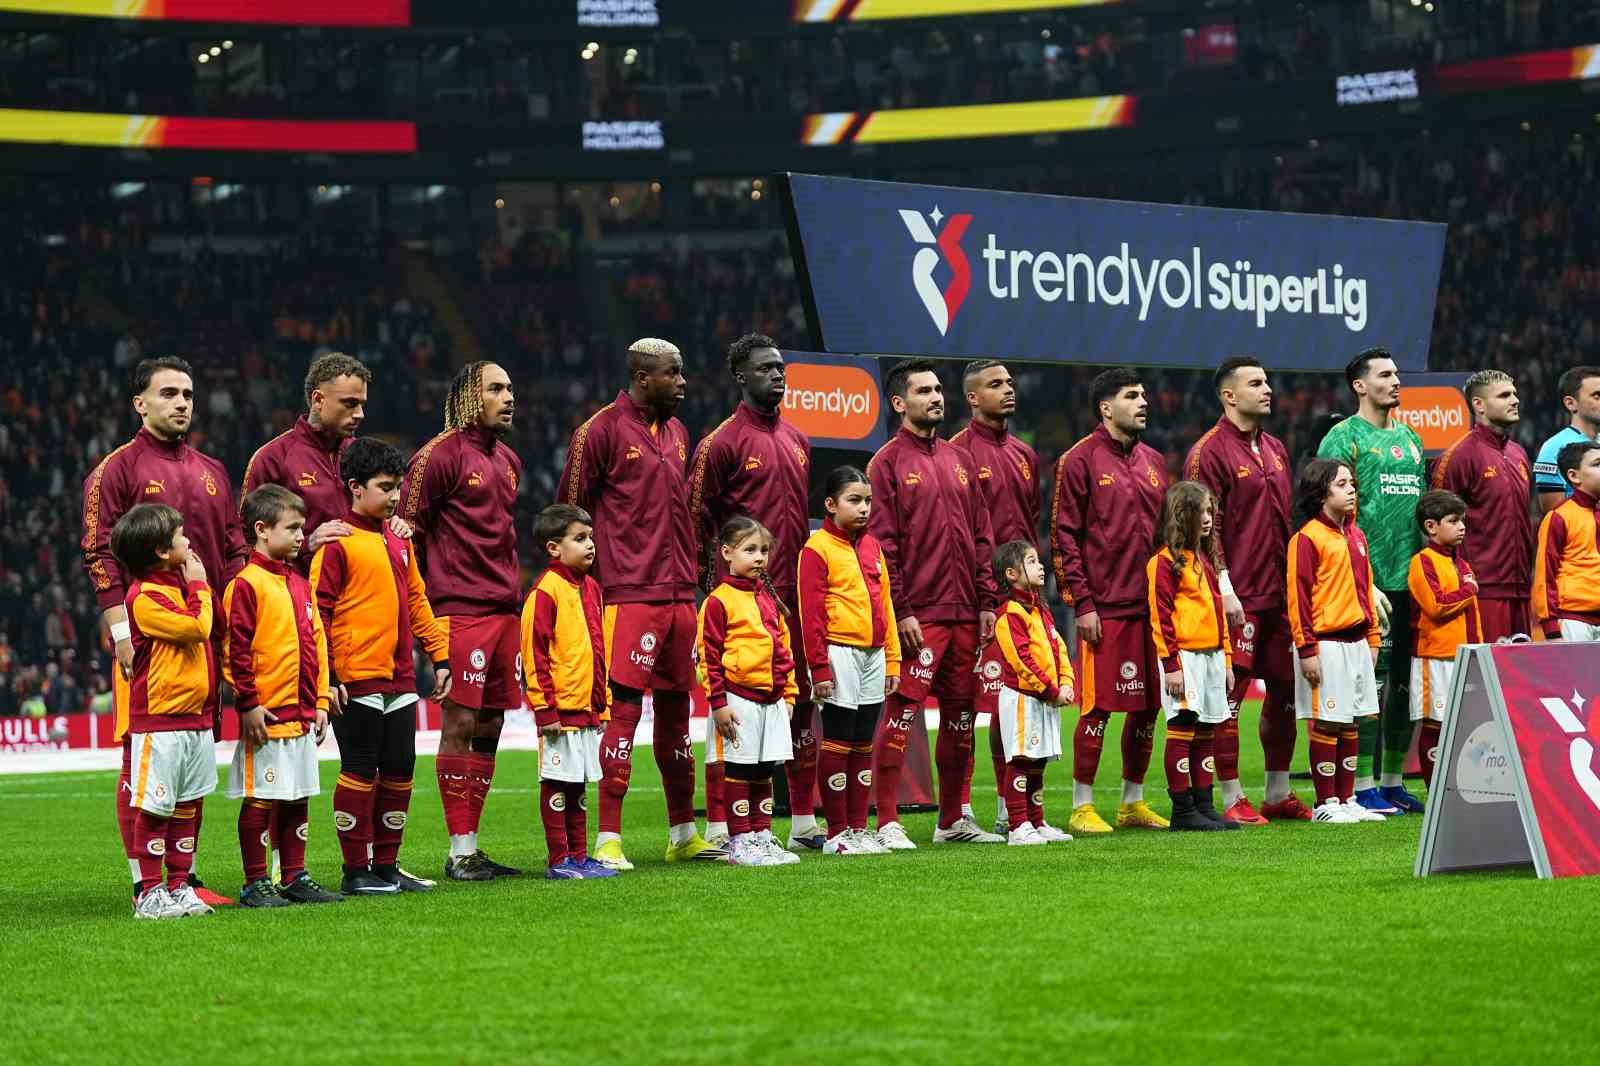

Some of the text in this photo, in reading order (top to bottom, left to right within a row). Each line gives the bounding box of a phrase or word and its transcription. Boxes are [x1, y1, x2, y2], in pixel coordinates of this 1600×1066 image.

[983, 234, 1367, 332] trendyol SüperLig
[784, 384, 870, 418] trendyol
[1381, 486, 1420, 497] HOLDIN
[630, 650, 656, 666] Lydia
[909, 665, 933, 679] Lydia
[981, 677, 1005, 694] ydia
[1115, 680, 1145, 694] Lydia
[0, 716, 69, 744] ULLS
